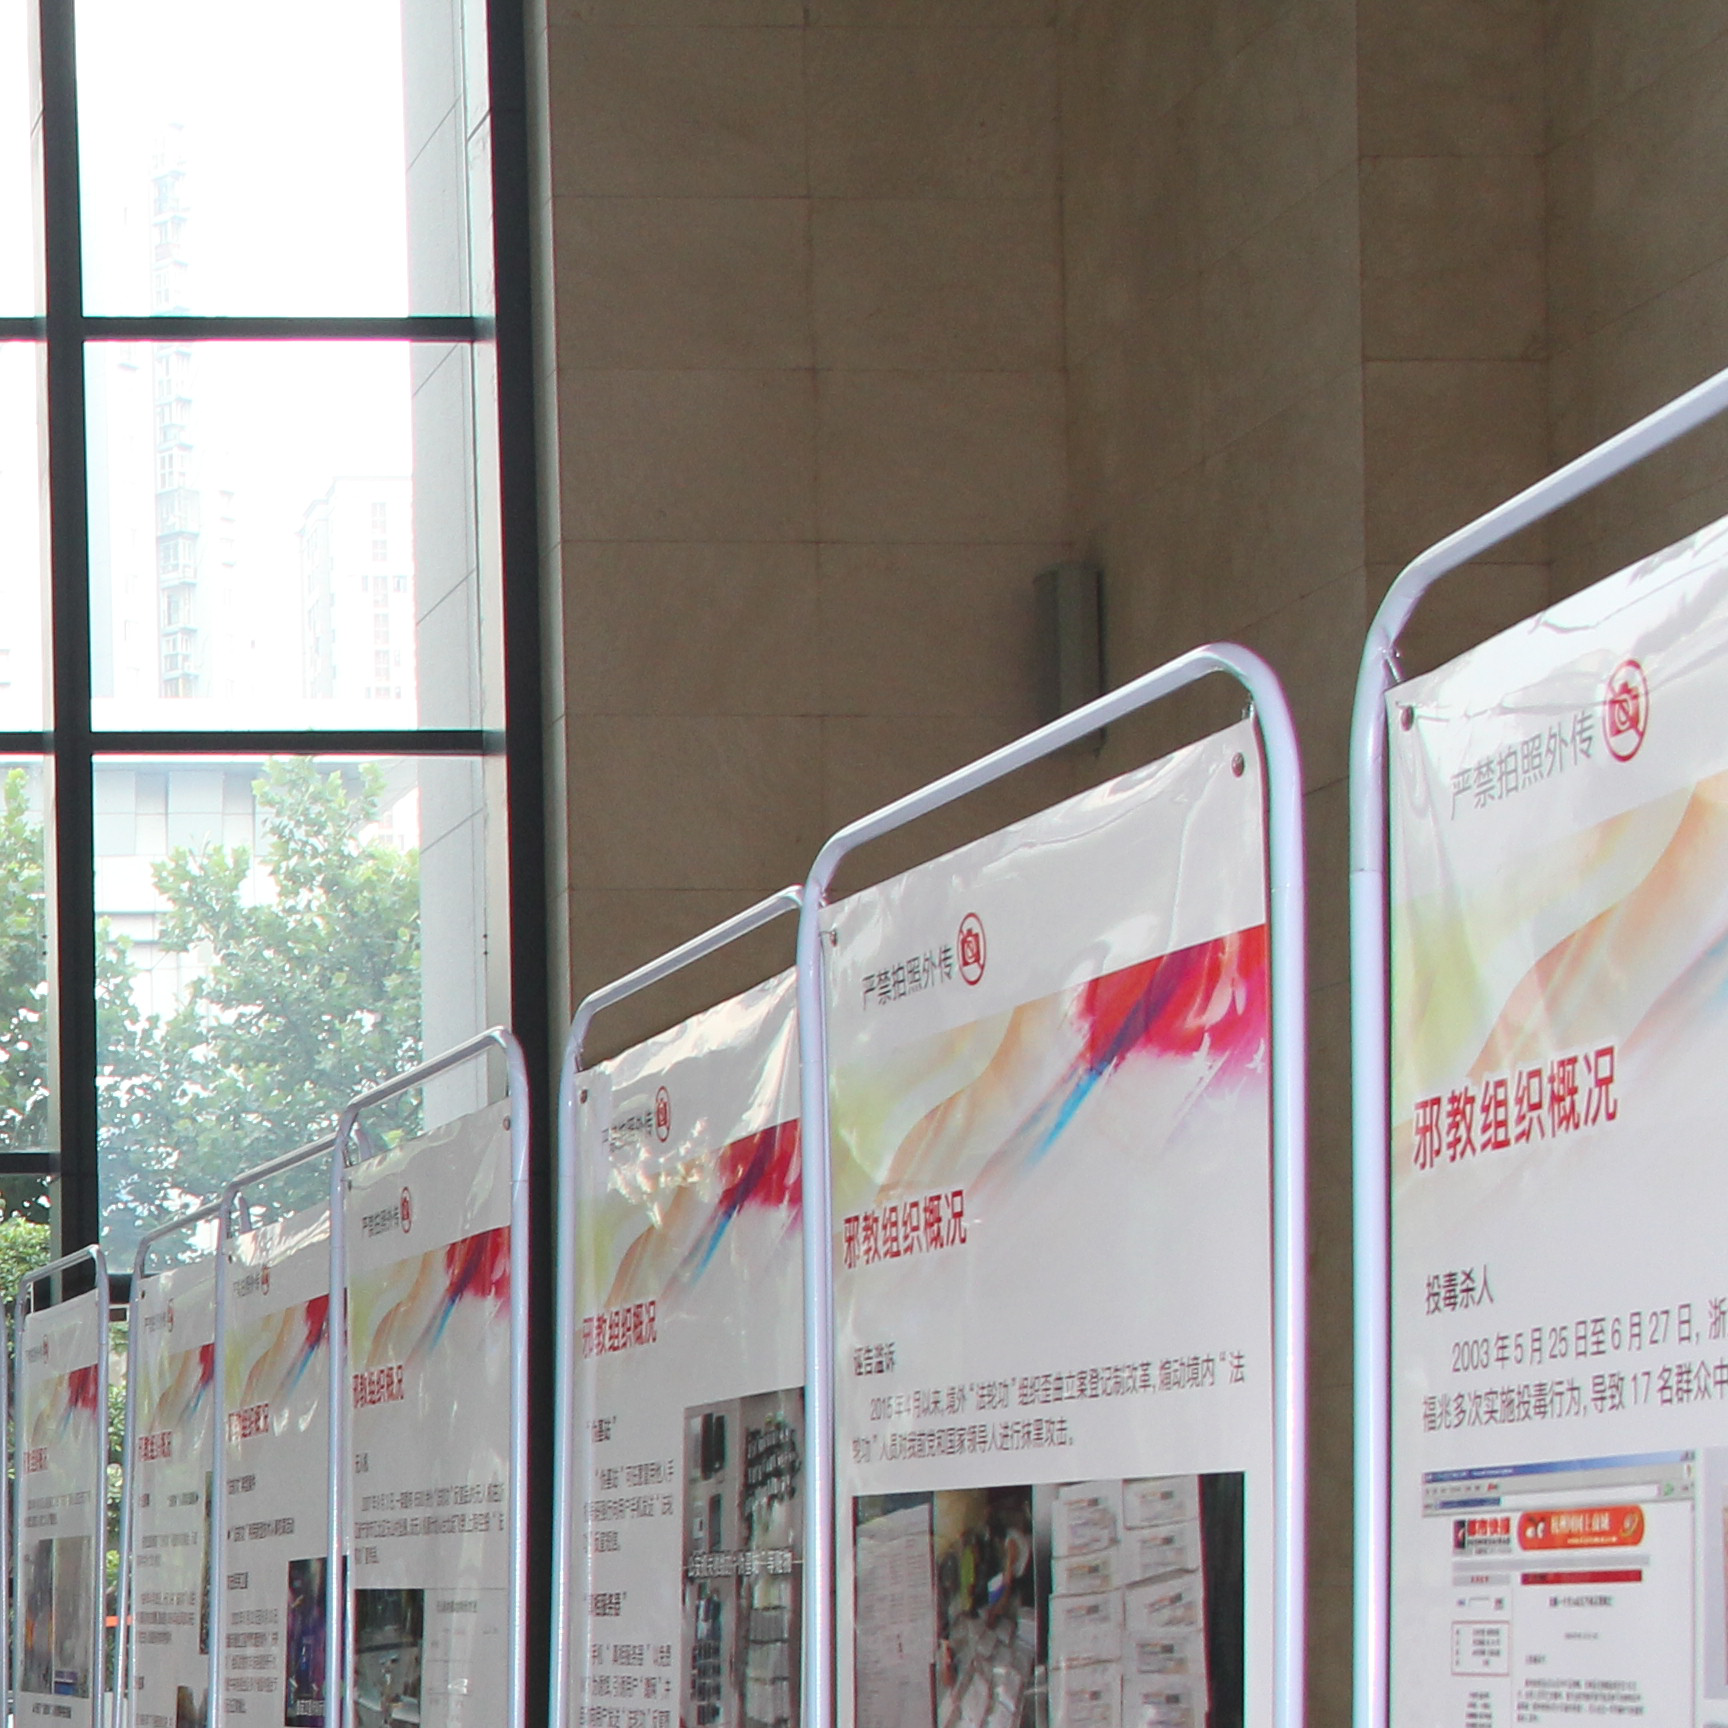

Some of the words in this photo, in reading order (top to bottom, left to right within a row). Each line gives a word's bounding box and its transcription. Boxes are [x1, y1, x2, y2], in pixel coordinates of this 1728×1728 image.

[1449, 709, 1594, 821] 严禁拍照外传
[861, 944, 955, 1012] 严禁拍照外传
[1412, 1043, 1619, 1171] 邪教组织概况
[844, 1189, 967, 1270] 邪教组织概况
[1425, 1263, 1494, 1316] 投毒杀人
